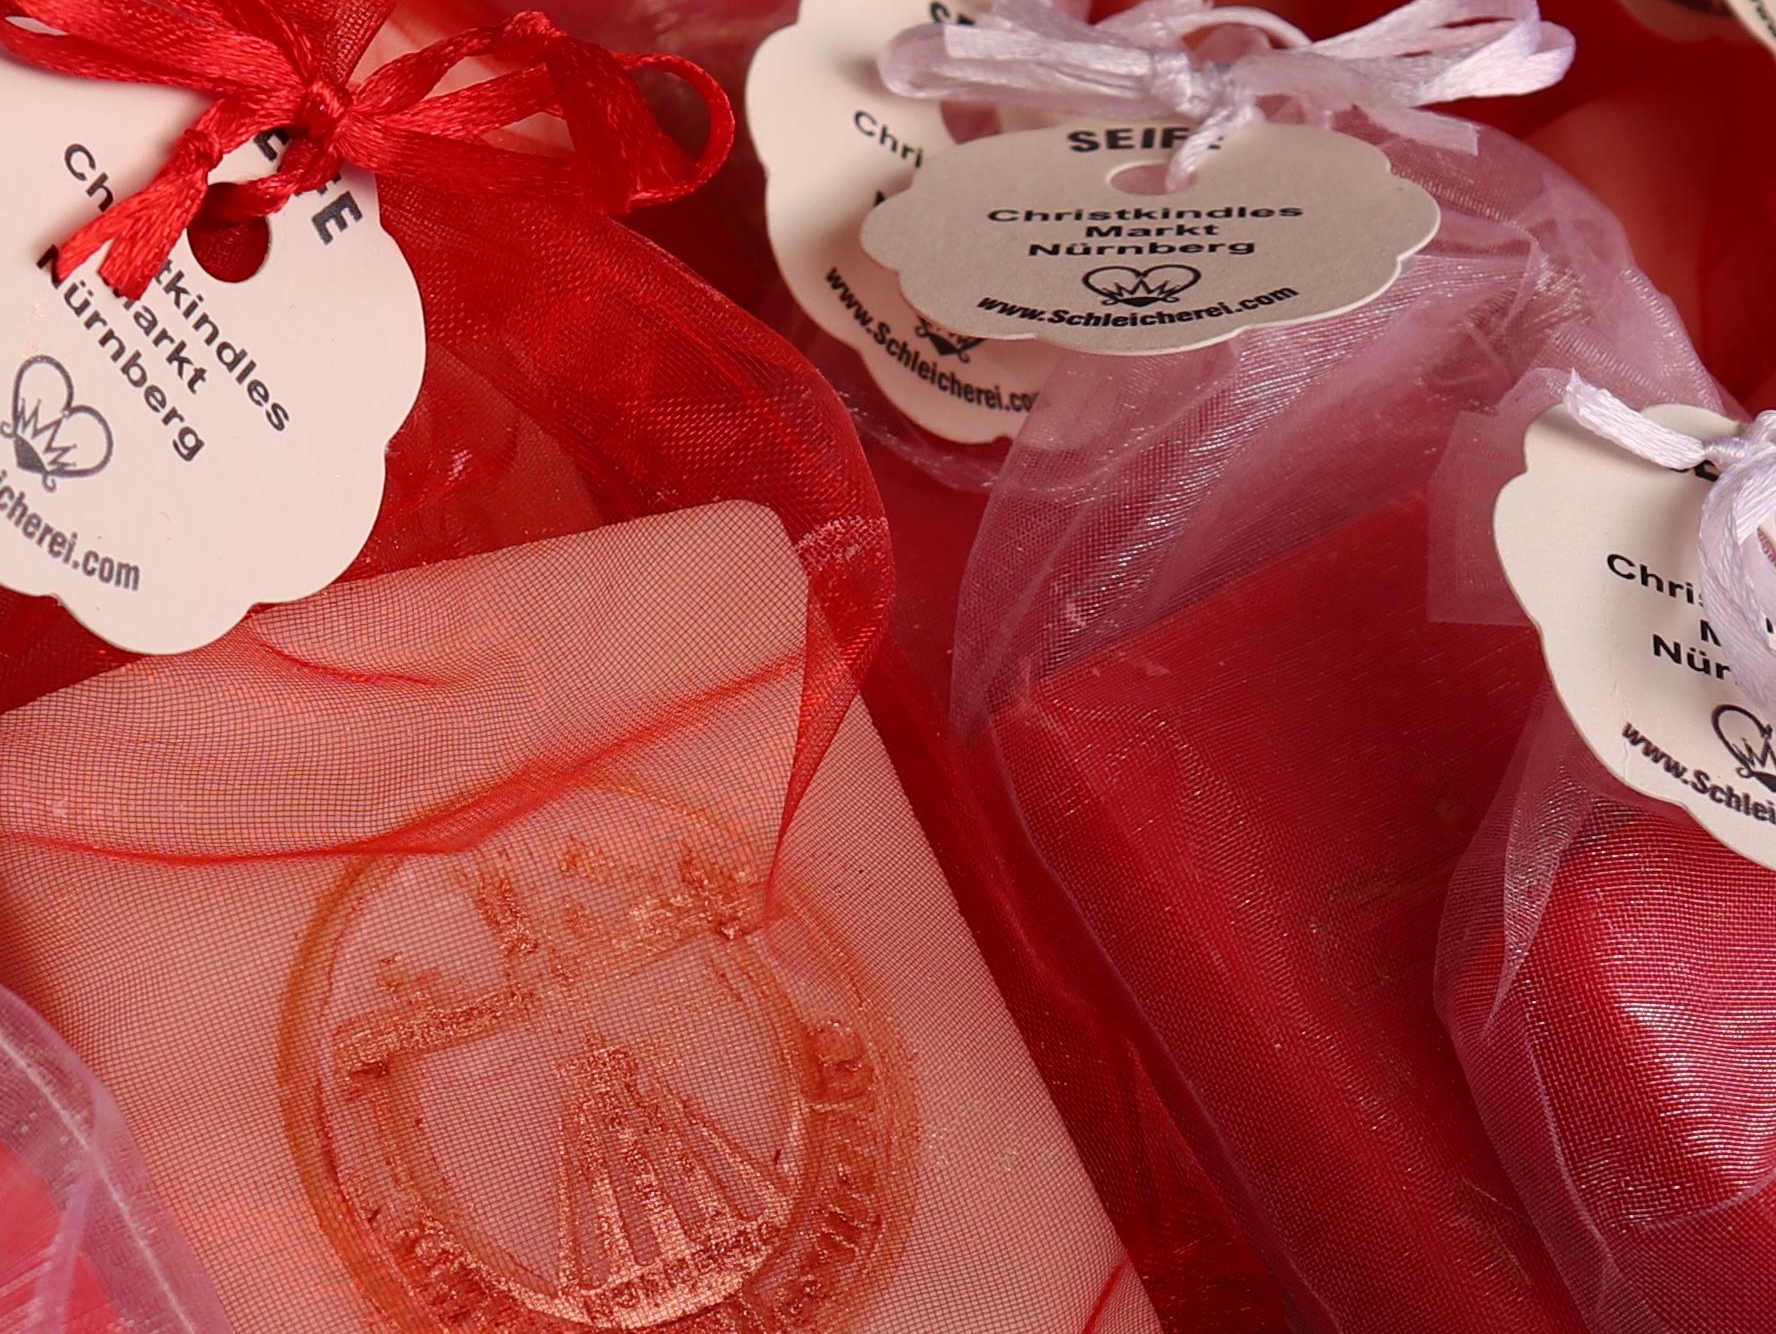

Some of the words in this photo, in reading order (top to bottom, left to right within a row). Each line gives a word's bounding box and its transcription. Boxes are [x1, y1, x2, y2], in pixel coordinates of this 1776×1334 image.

[1067, 126, 1224, 153] SEIF
[987, 206, 1305, 222] Christkindles
[1084, 223, 1221, 239] Markt
[1027, 240, 1257, 257] Nürnberg
[976, 285, 1301, 328] www.Schleicherei.com
[35, 243, 205, 463] Nürnberg
[121, 289, 208, 395] arkt
